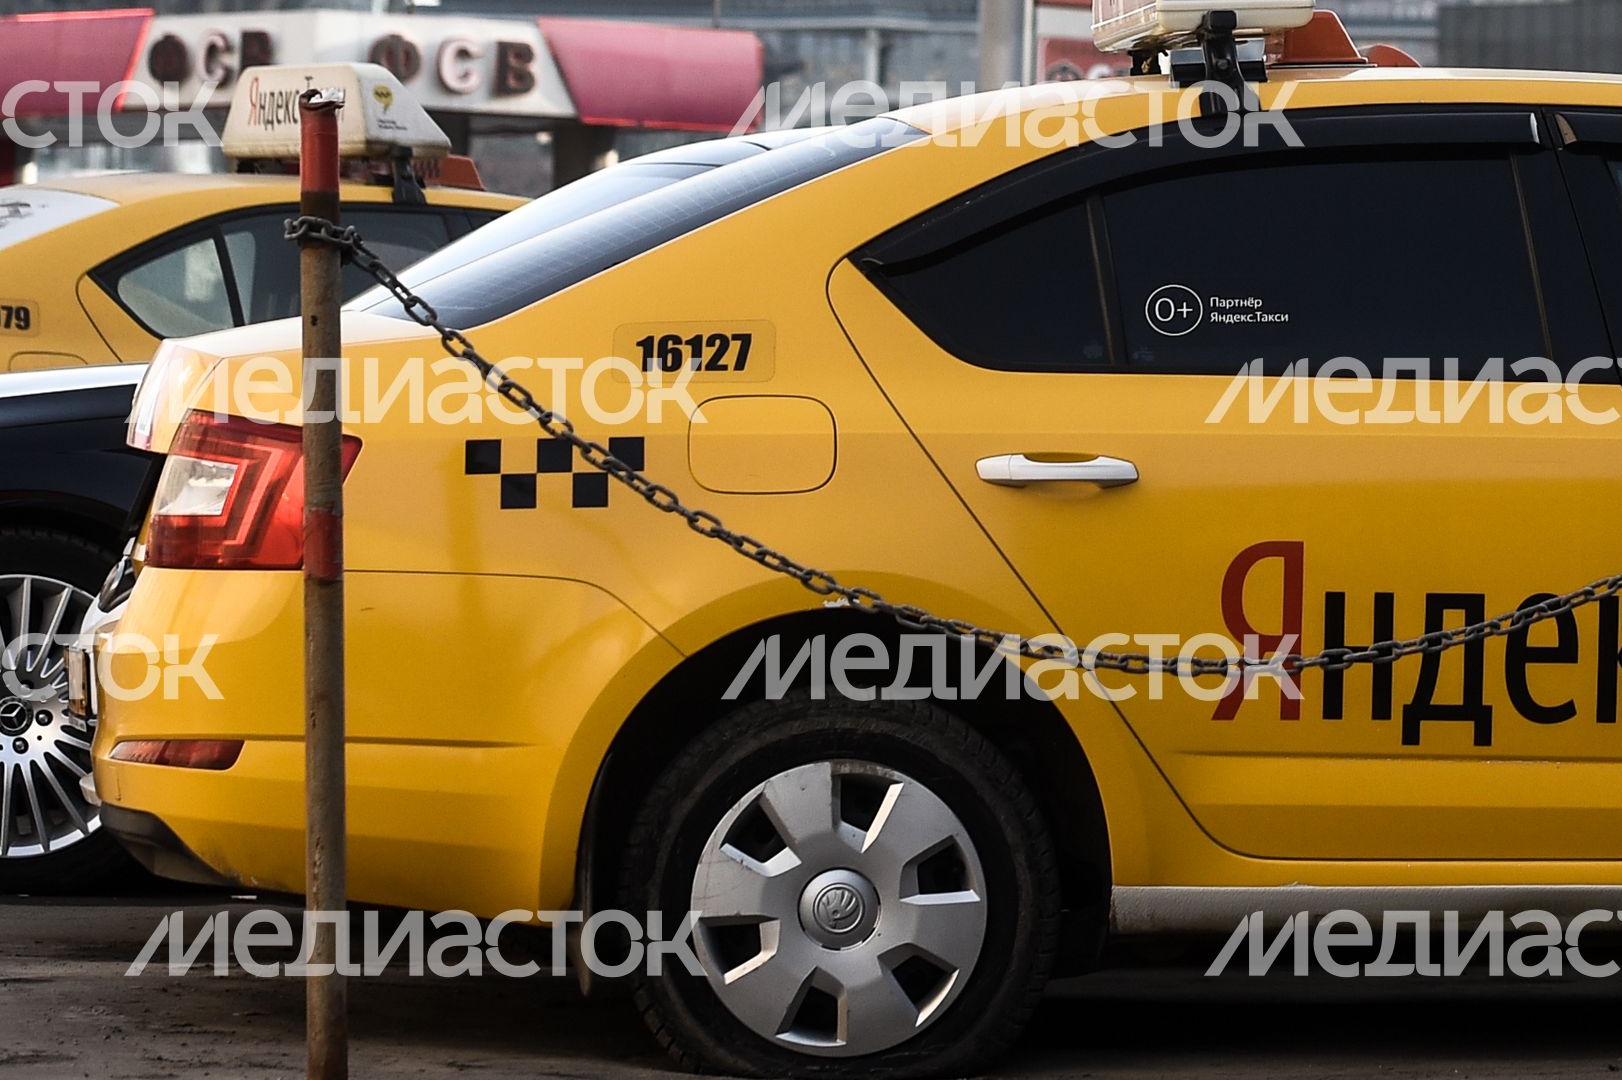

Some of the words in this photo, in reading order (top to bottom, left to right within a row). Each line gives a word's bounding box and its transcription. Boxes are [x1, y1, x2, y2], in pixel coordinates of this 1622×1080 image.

[1155, 297, 1193, 322] 0+
[1210, 296, 1263, 310] Партнёр
[1210, 311, 1289, 325] Яндекс.Такси
[635, 333, 753, 373] 16127
